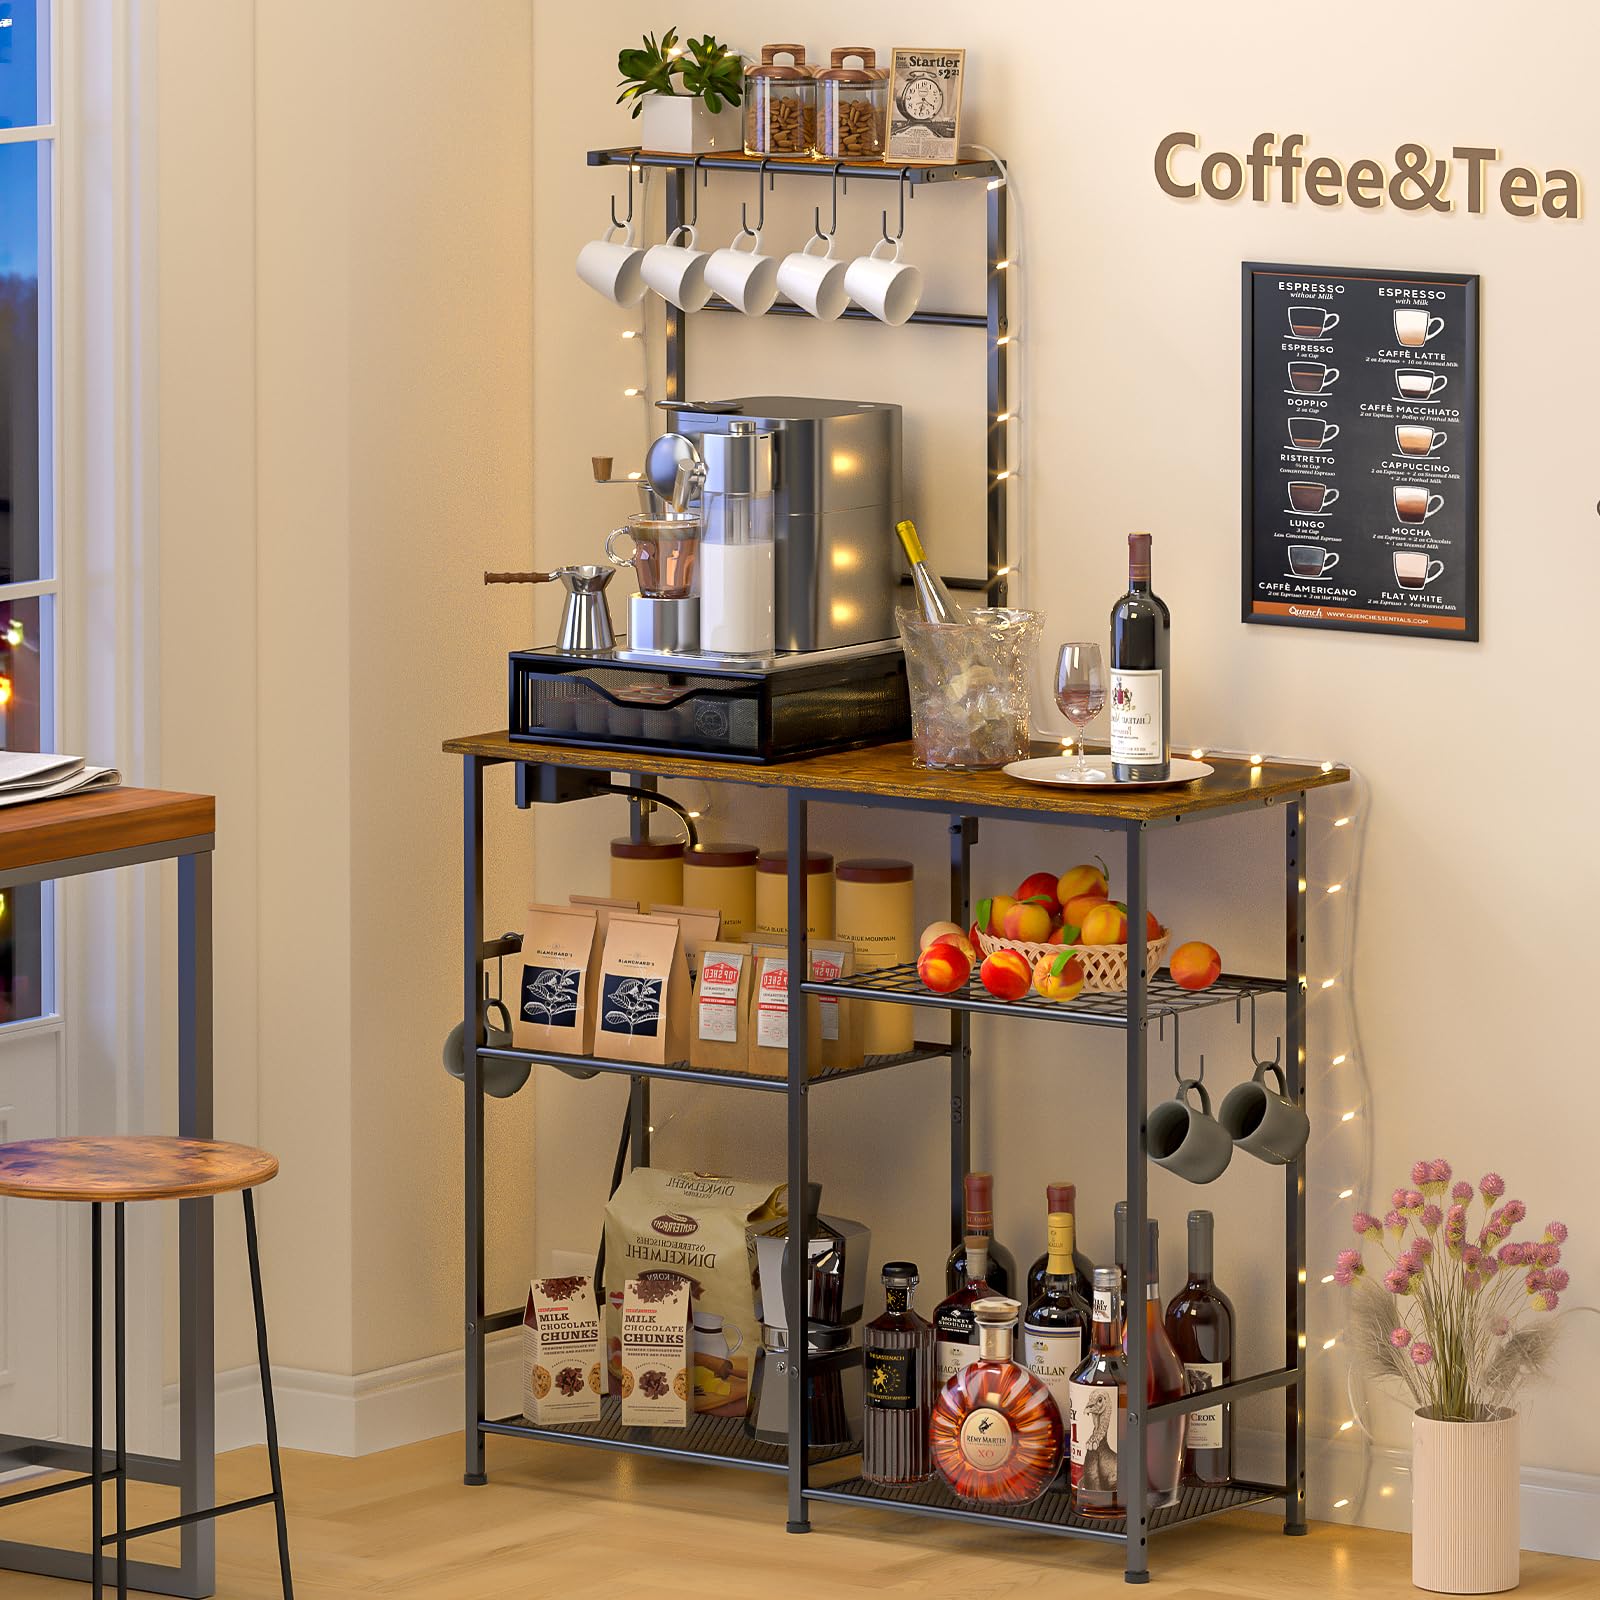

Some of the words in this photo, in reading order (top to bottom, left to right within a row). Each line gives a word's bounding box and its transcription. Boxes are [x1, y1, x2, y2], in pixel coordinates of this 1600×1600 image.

[909, 55, 961, 68] Startler
[1154, 131, 1581, 220] Coffee&Tea
[1278, 281, 1345, 294] ESPRESSO
[1378, 287, 1447, 301] ESPRESSO
[1281, 343, 1334, 354] ESPRESSO
[1308, 352, 1320, 360] Cup
[1378, 349, 1411, 359] CAFFÈ
[1414, 352, 1447, 361] LATTE
[1287, 398, 1329, 408] DOPPIO
[1360, 403, 1393, 414] CAFFÈ
[1396, 405, 1461, 418] MACCHIATO
[1280, 454, 1335, 465] RISTRETTO
[1381, 461, 1450, 474] CAPPUCCINO
[1290, 519, 1326, 530] LUNGO
[1285, 533, 1320, 541] Concentrated
[1392, 527, 1432, 538] MOCHA
[1258, 582, 1291, 592] CAFFÈ
[1294, 584, 1357, 597] AMERICANO
[1381, 592, 1406, 602] FLAT
[1408, 594, 1443, 604] WHITE
[1288, 605, 1323, 618] Quench
[539, 1313, 570, 1323] MILK
[625, 1315, 657, 1323] MILK
[941, 1315, 970, 1324] MONKEY
[540, 1320, 598, 1331] CHOCOLATE
[624, 1325, 684, 1333] CHOCOLATE
[541, 1329, 599, 1342] CHUNKS
[623, 1333, 684, 1344] CHUNKS
[982, 1436, 1007, 1444] MARTIN
[977, 1449, 994, 1459] XO
